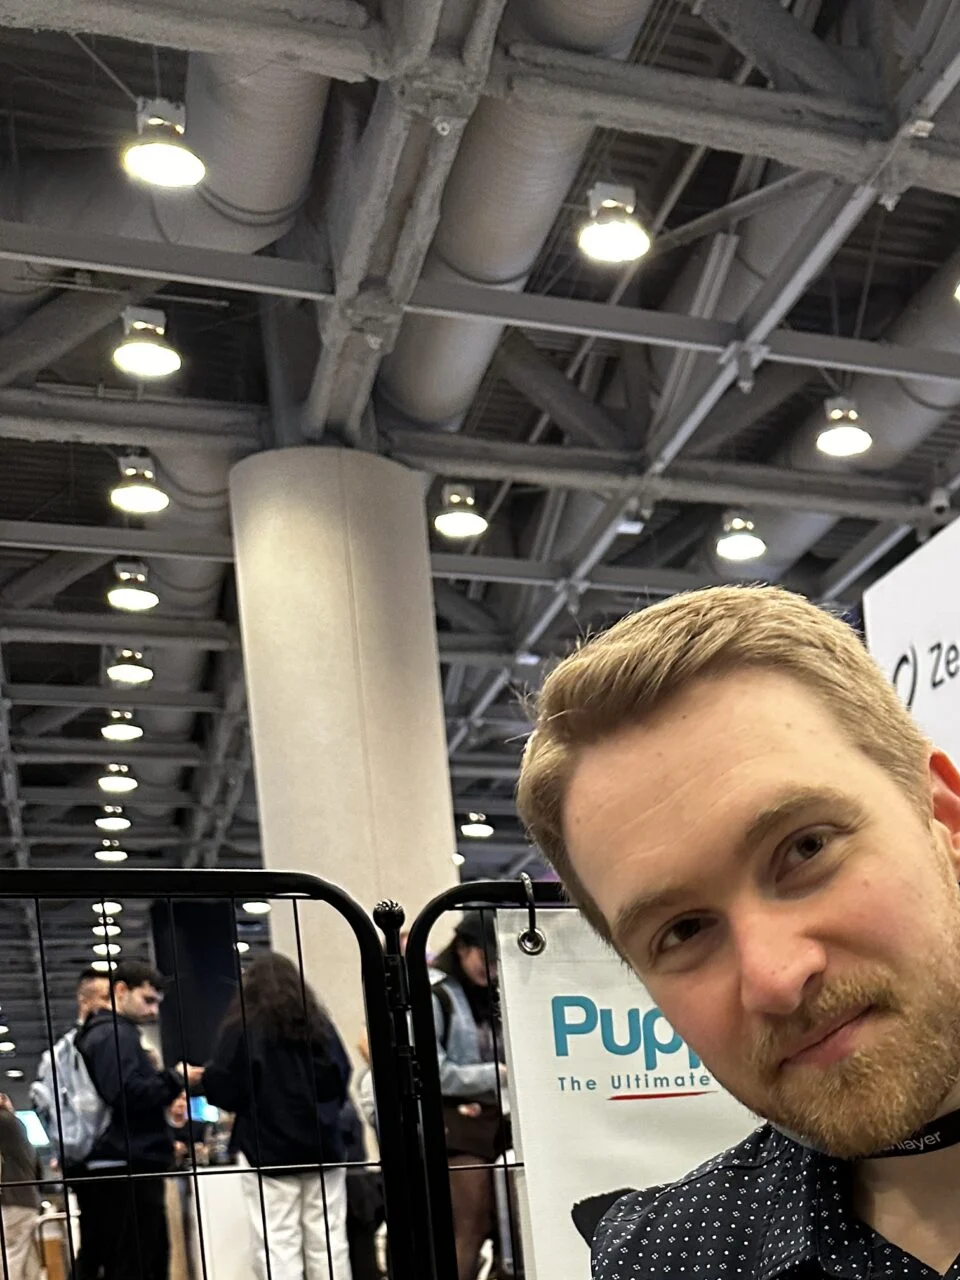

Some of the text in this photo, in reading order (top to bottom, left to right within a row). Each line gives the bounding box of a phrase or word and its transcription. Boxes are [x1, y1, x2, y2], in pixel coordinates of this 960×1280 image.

[558, 1072, 711, 1091] The Ultimate
[888, 1131, 941, 1151] layer
